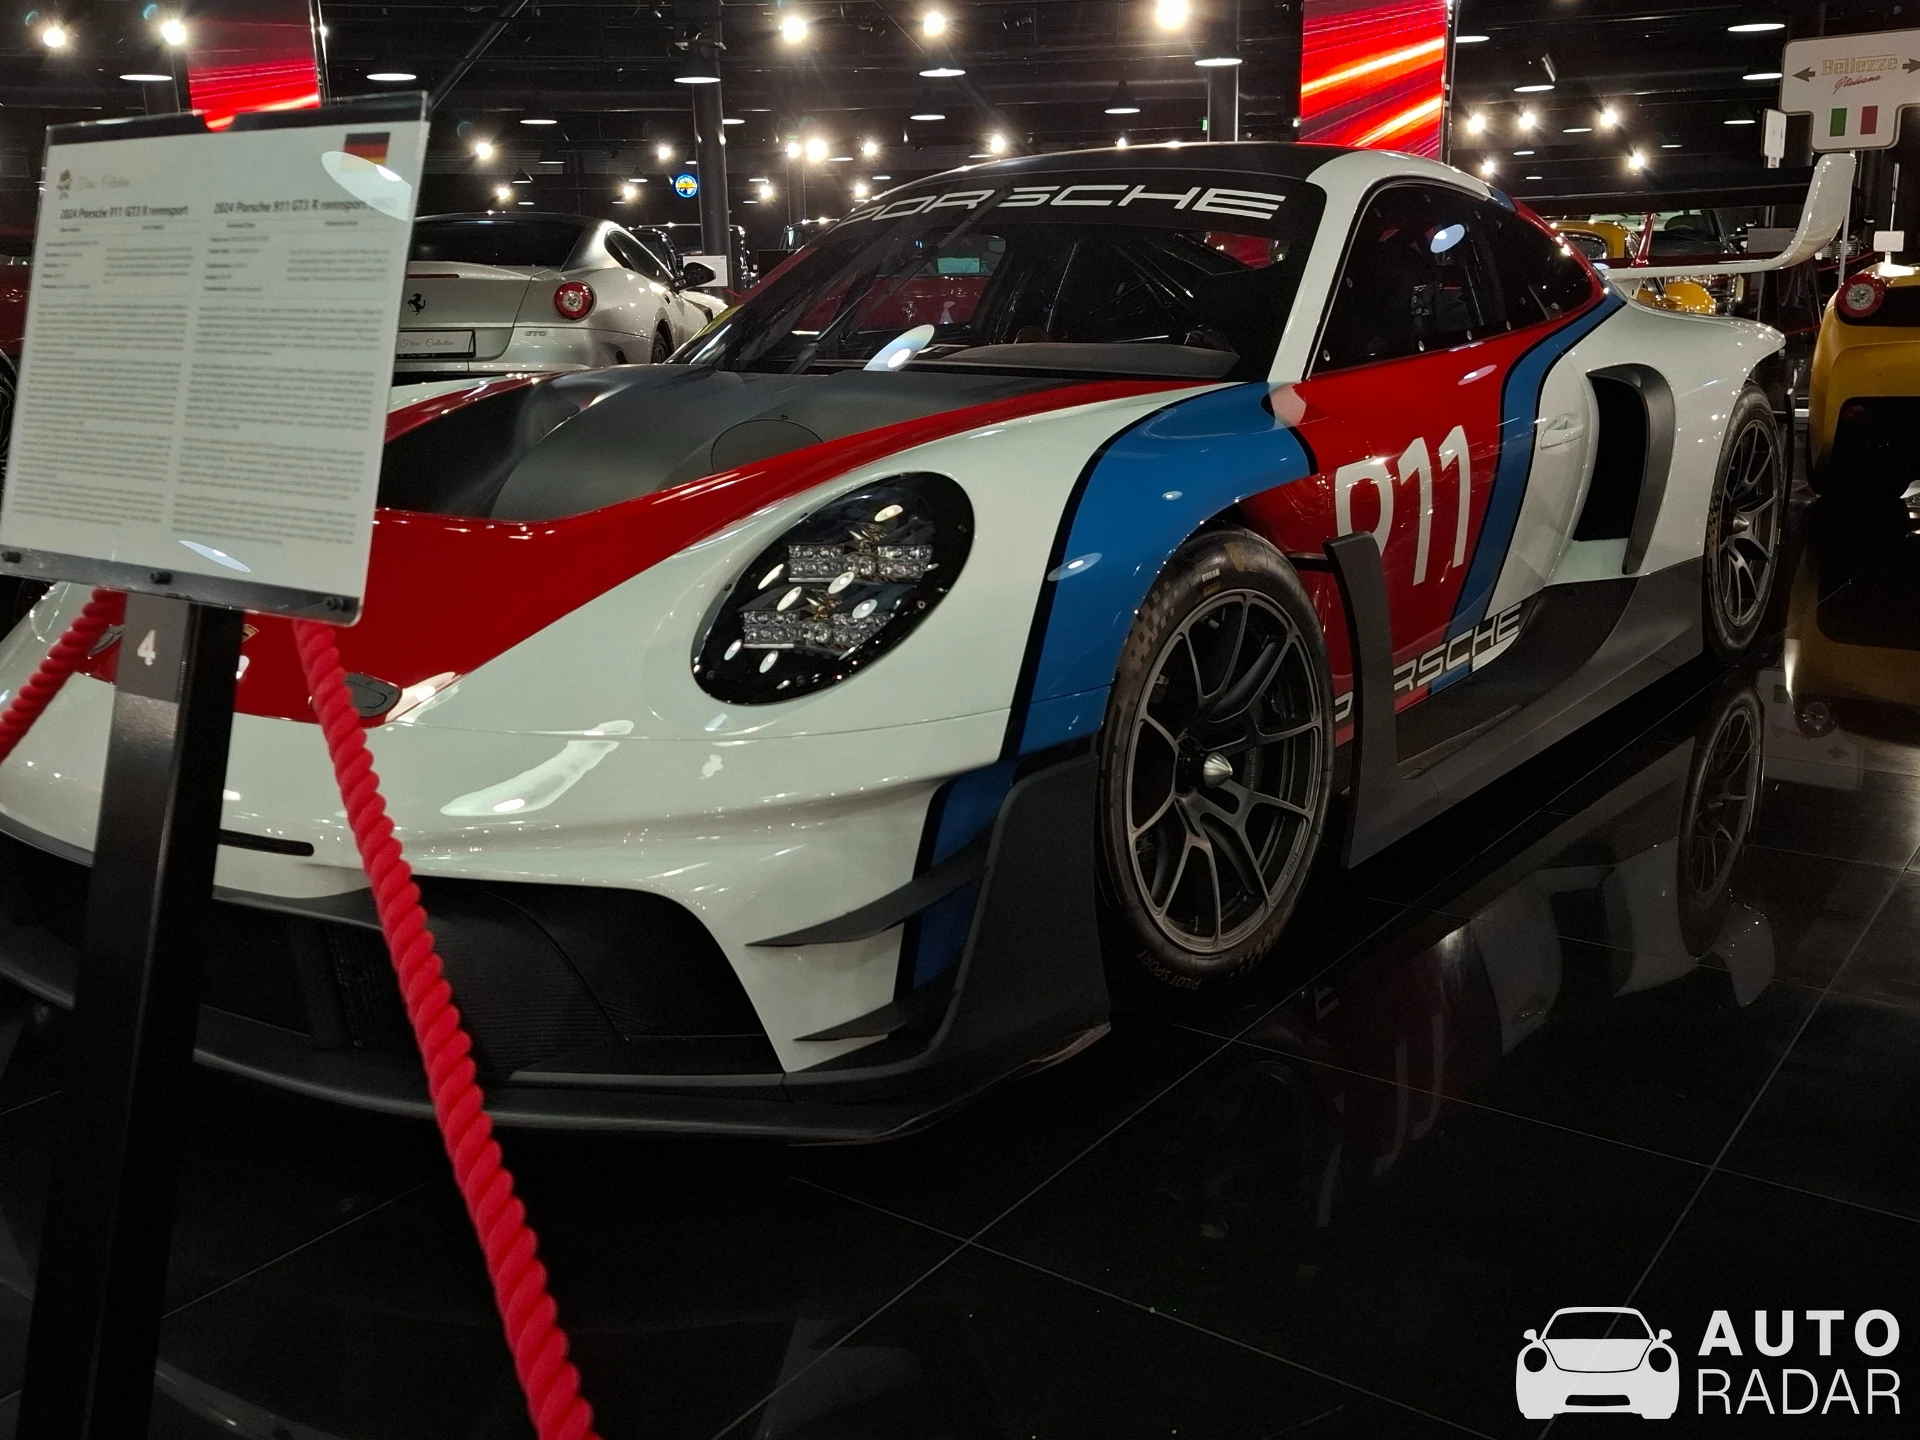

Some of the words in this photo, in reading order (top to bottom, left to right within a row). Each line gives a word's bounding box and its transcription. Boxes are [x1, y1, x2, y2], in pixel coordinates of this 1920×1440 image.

[1821, 56, 1898, 76] Bellezze
[1335, 425, 1471, 586] 911
[137, 629, 157, 665] 4
[1137, 950, 1172, 981] SPORT
